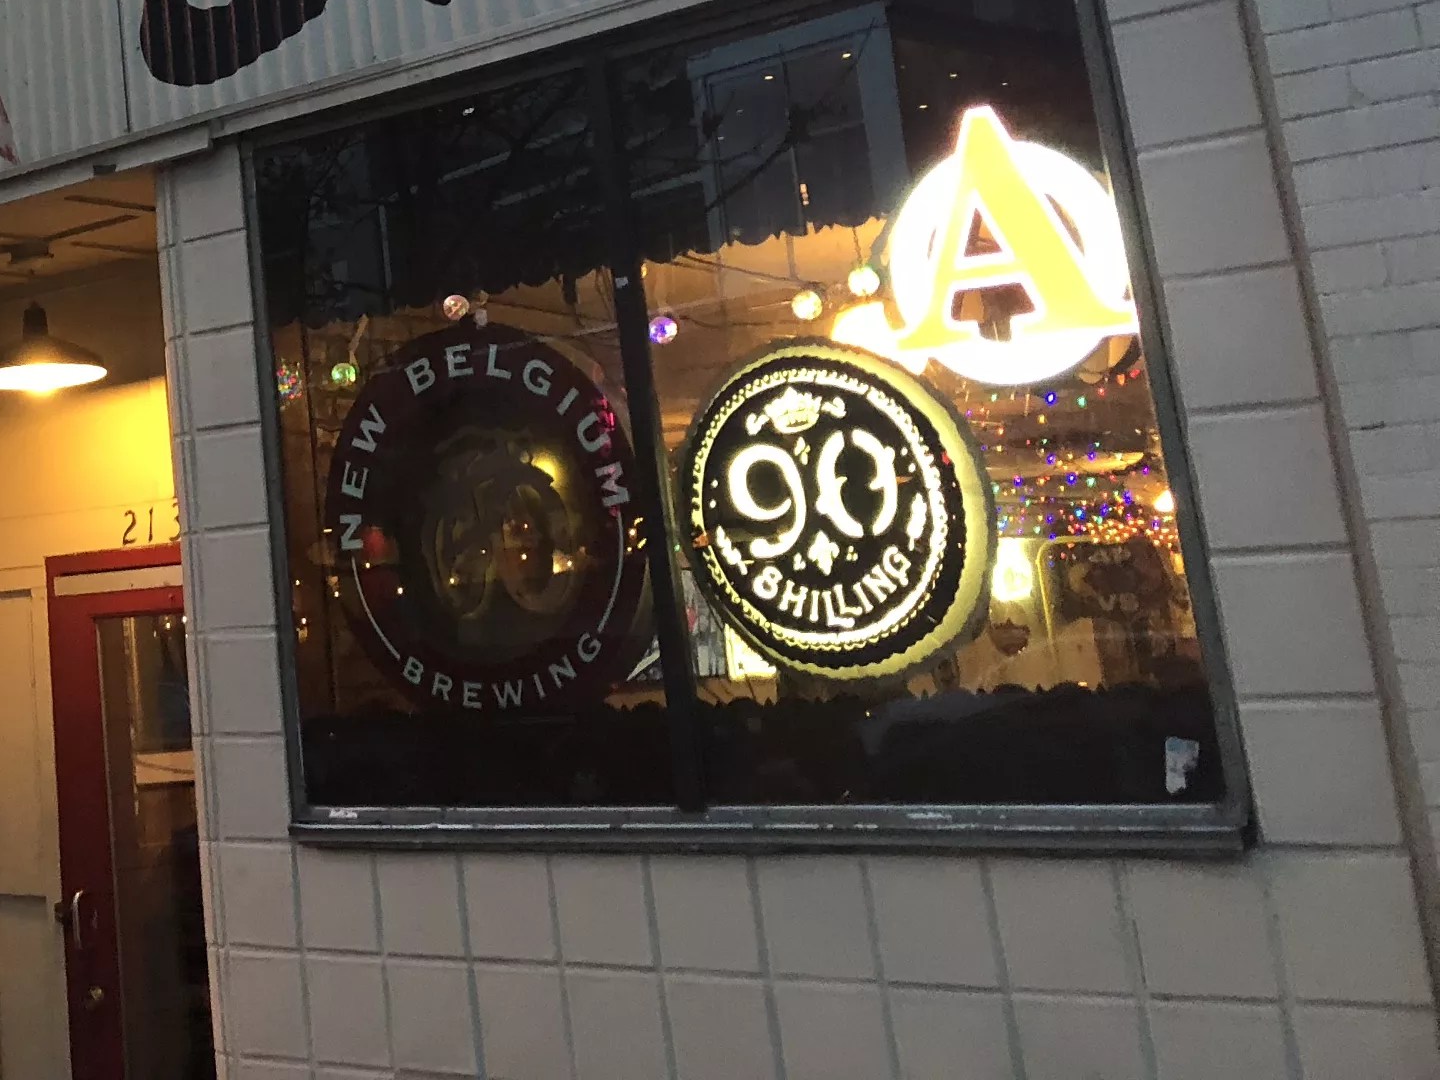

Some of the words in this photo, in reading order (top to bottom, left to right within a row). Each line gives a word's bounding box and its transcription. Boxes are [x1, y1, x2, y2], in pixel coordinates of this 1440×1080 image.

[339, 403, 387, 552] NEW
[404, 343, 630, 508] BELGIUM
[727, 428, 898, 559] 90
[403, 631, 602, 710] BREWING
